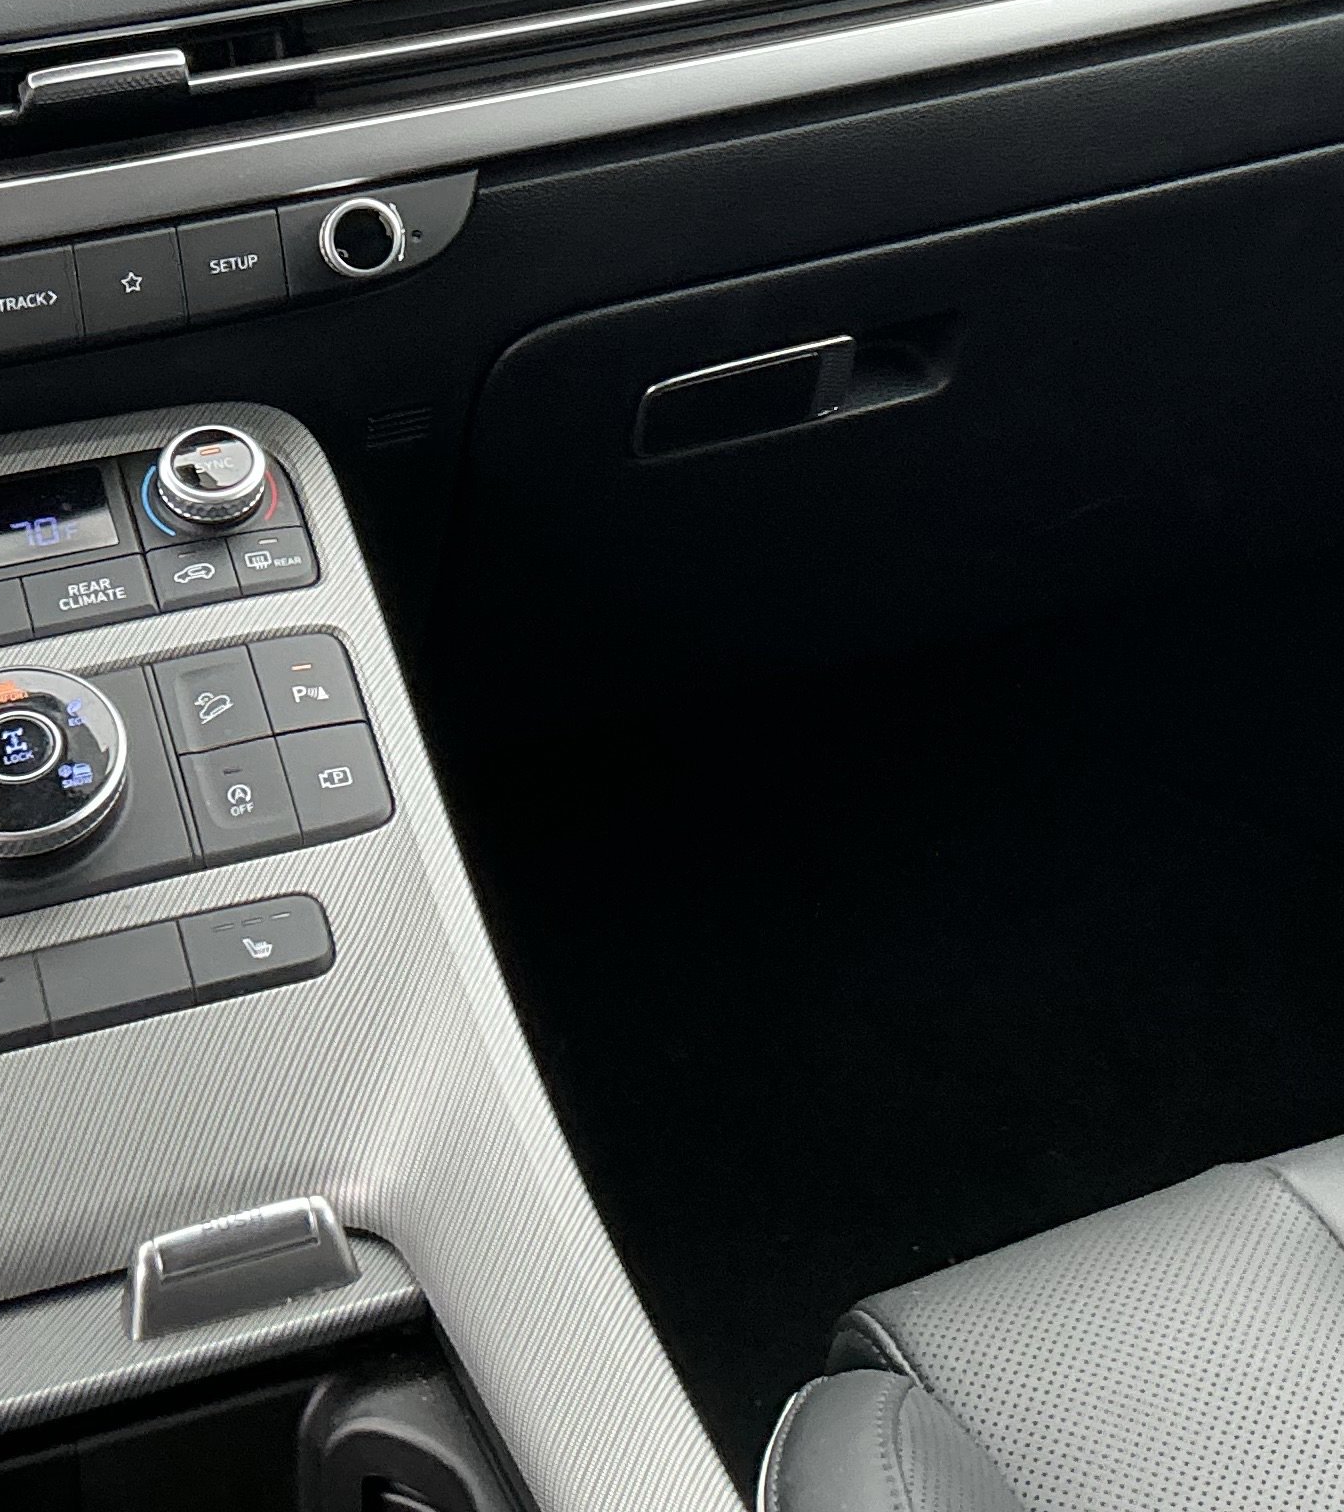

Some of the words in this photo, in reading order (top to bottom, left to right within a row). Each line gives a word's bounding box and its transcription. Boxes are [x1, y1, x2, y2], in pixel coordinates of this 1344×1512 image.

[209, 253, 258, 275] SETUP
[195, 457, 234, 474] SYNC
[273, 555, 302, 568] REAR
[67, 578, 112, 597] REAR
[58, 587, 127, 612] CLIMATE
[3, 750, 35, 765] LOCK
[230, 802, 254, 817] OFF
